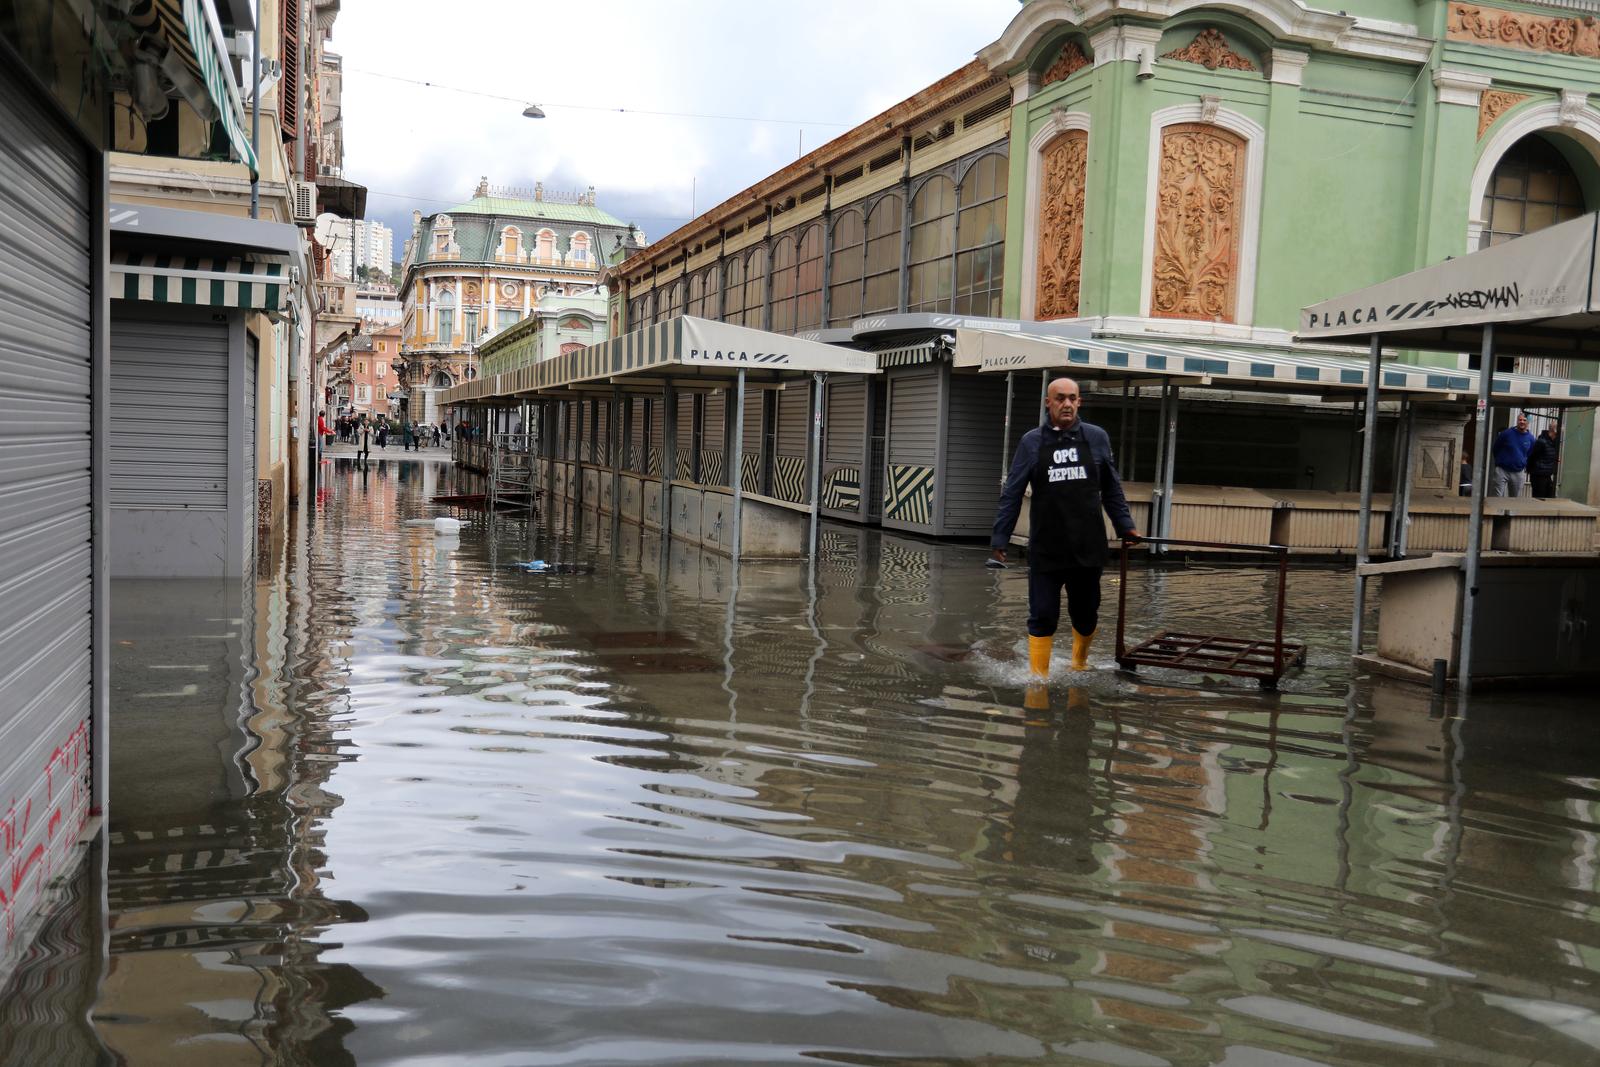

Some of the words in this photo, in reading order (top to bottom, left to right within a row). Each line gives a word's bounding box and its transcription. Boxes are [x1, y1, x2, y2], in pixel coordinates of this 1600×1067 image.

[1309, 307, 1378, 329] PLACA
[691, 349, 748, 361] PLACA
[984, 356, 1009, 368] PLACA
[1053, 447, 1078, 464] OPG
[1048, 466, 1087, 483] ŽEPINA
